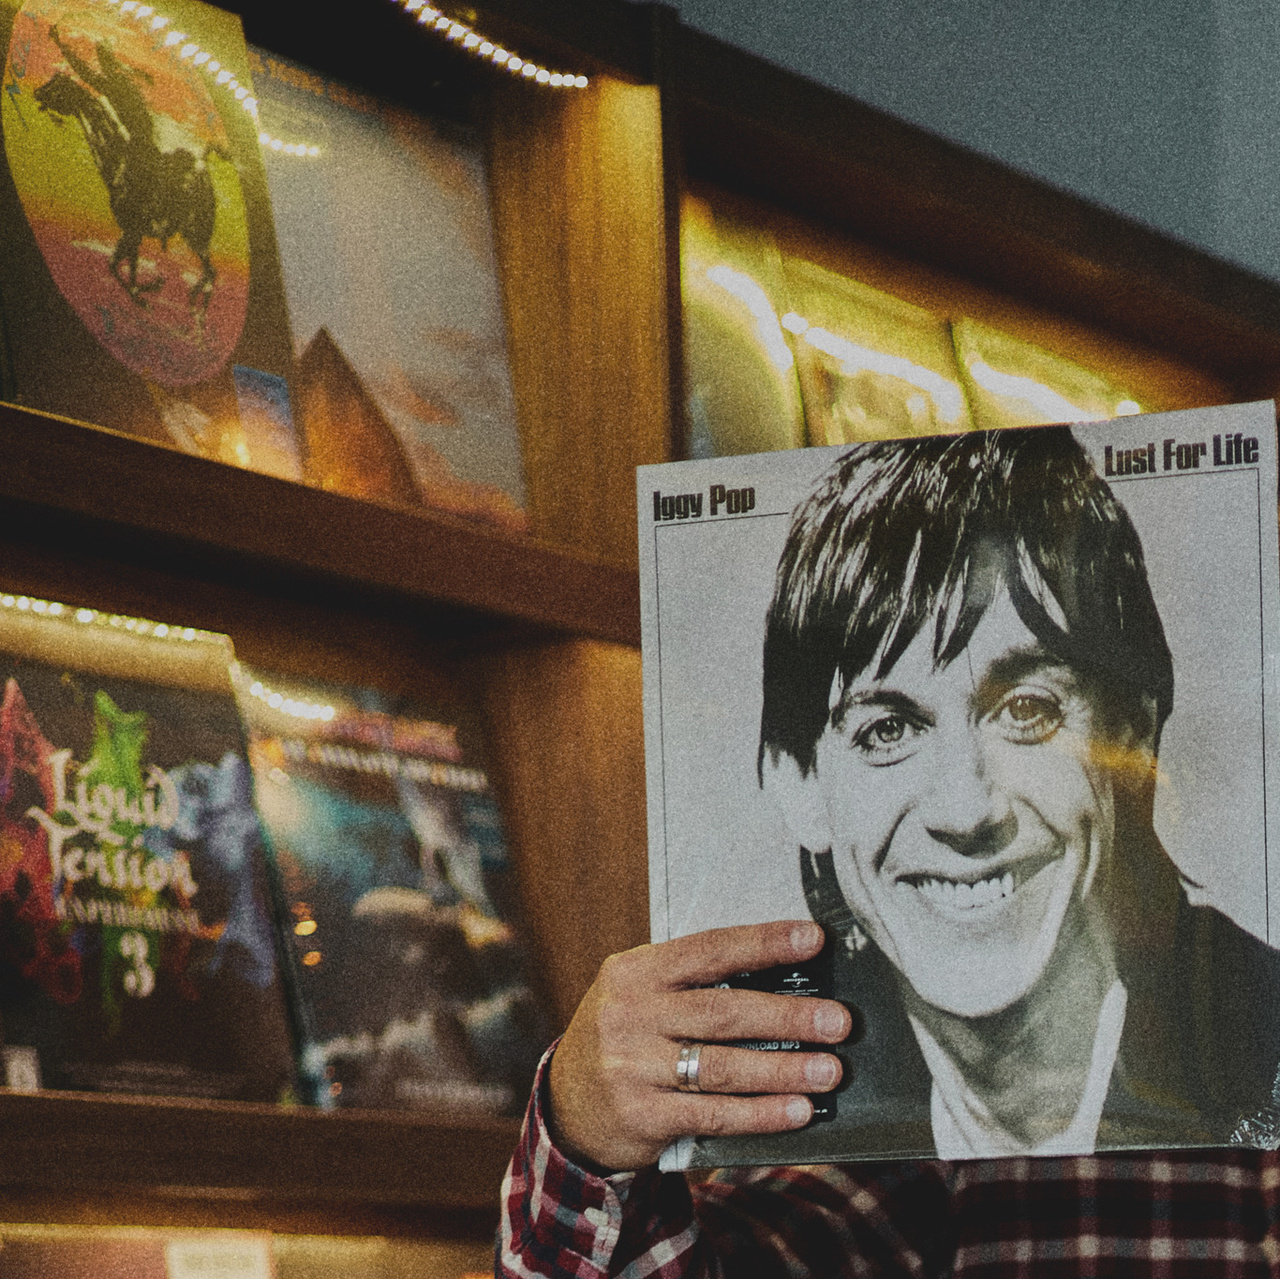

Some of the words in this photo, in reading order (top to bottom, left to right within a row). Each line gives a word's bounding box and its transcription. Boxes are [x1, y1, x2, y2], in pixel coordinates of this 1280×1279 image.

[1104, 442, 1156, 477] Lust
[1163, 438, 1206, 471] For
[1213, 432, 1259, 467] Life
[653, 489, 703, 522] Iggy
[710, 483, 756, 516] Pop
[781, 1040, 801, 1050] MP3
